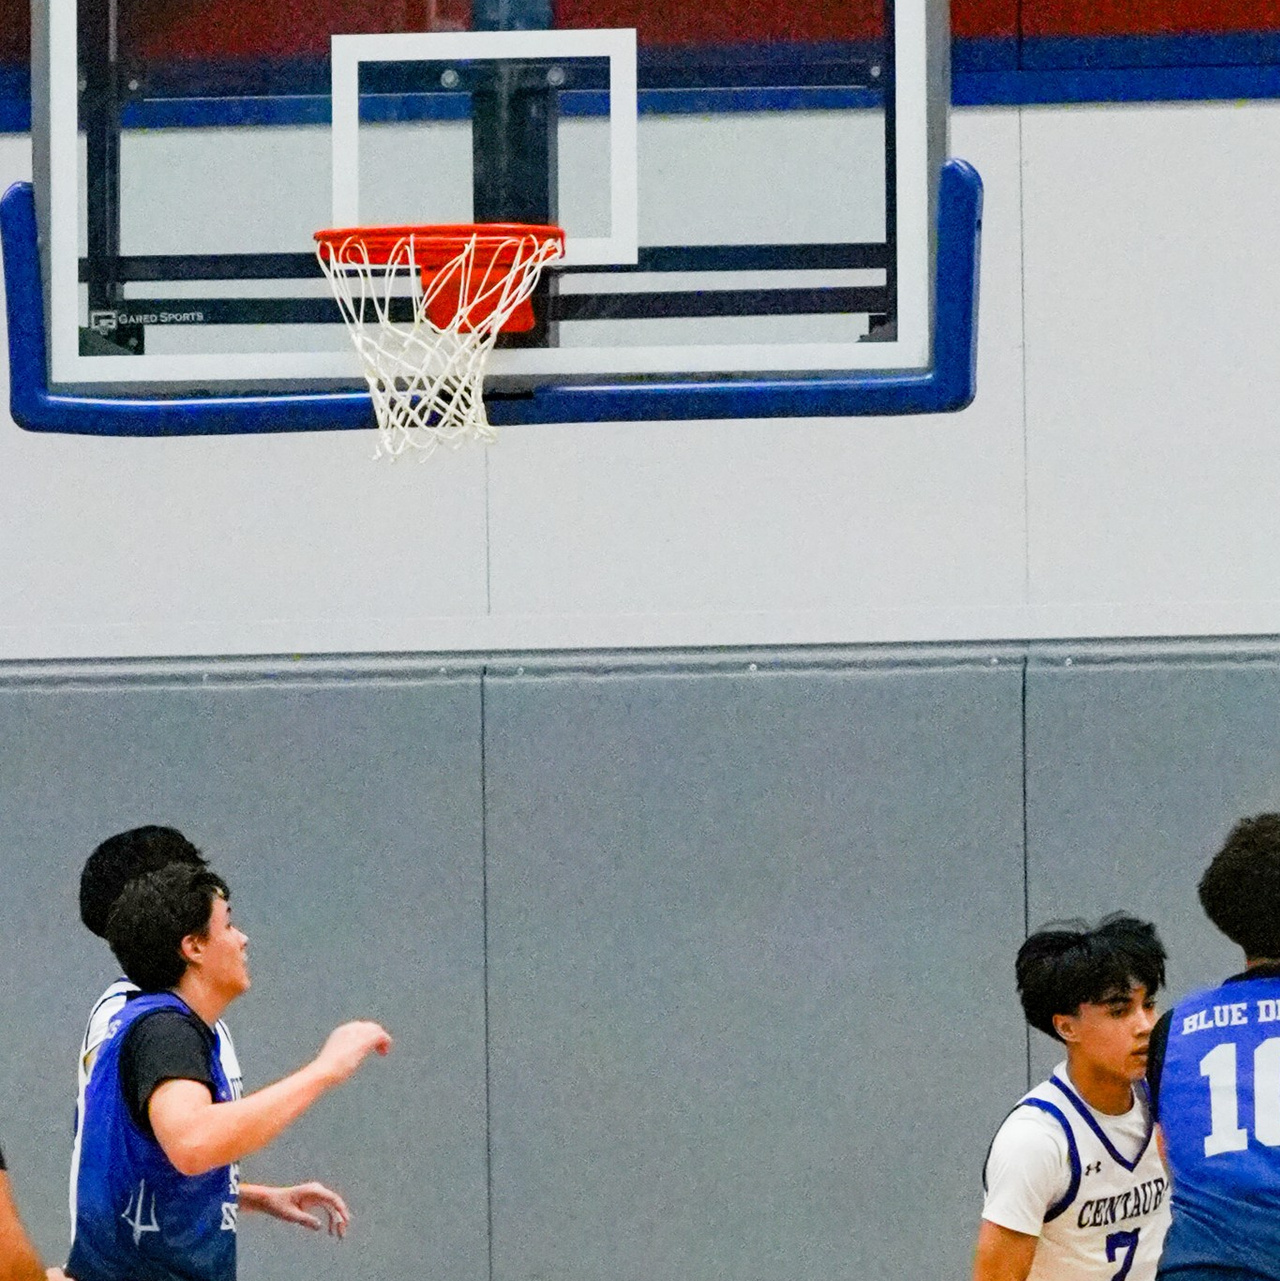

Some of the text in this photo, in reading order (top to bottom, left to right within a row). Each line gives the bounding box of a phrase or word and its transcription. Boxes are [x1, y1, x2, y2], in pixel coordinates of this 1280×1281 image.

[118, 312, 204, 325] GARED SPORTS
[1182, 1002, 1248, 1035] BLUE
[1077, 1177, 1170, 1228] CENTAUR
